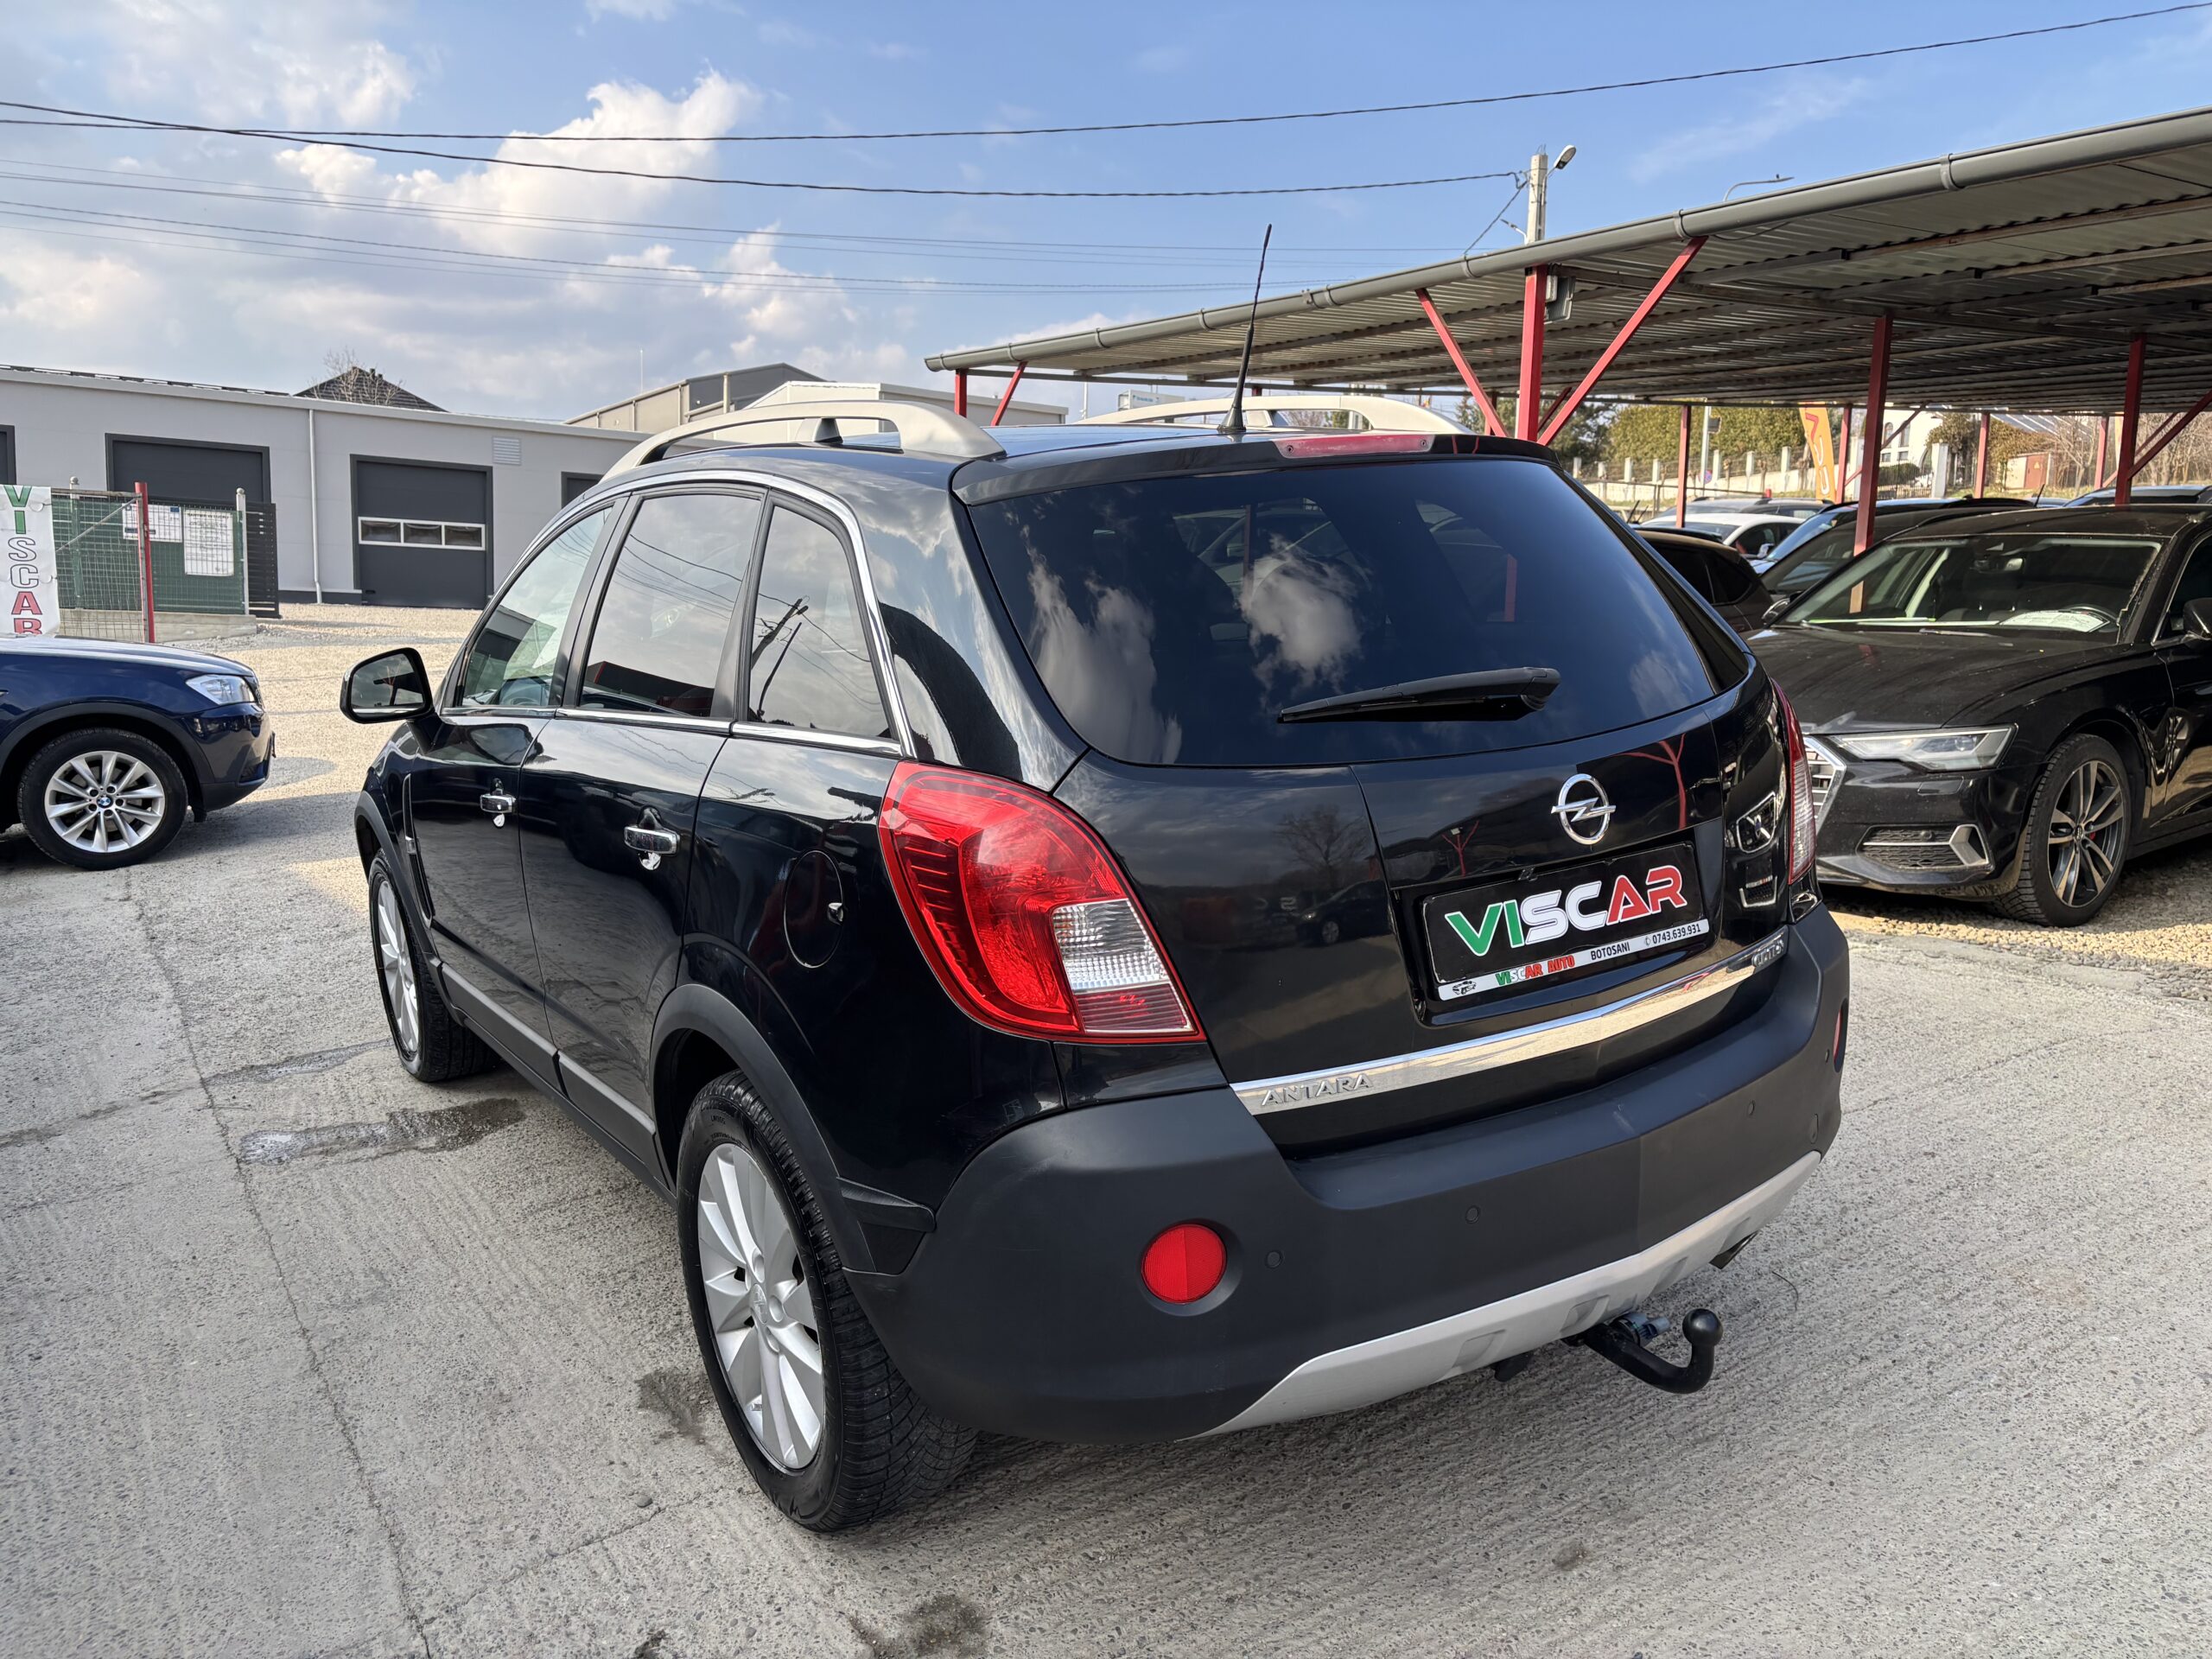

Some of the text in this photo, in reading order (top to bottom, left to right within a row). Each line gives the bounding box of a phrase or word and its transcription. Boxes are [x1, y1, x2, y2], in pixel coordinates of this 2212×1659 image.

[3, 485, 43, 635] VISCAR
[1445, 865, 1688, 957] VISCAR
[1495, 924, 1701, 986] VISCAR AUTO BOTOSANI 0743.639.931
[1262, 1073, 1373, 1106] ANTARA
